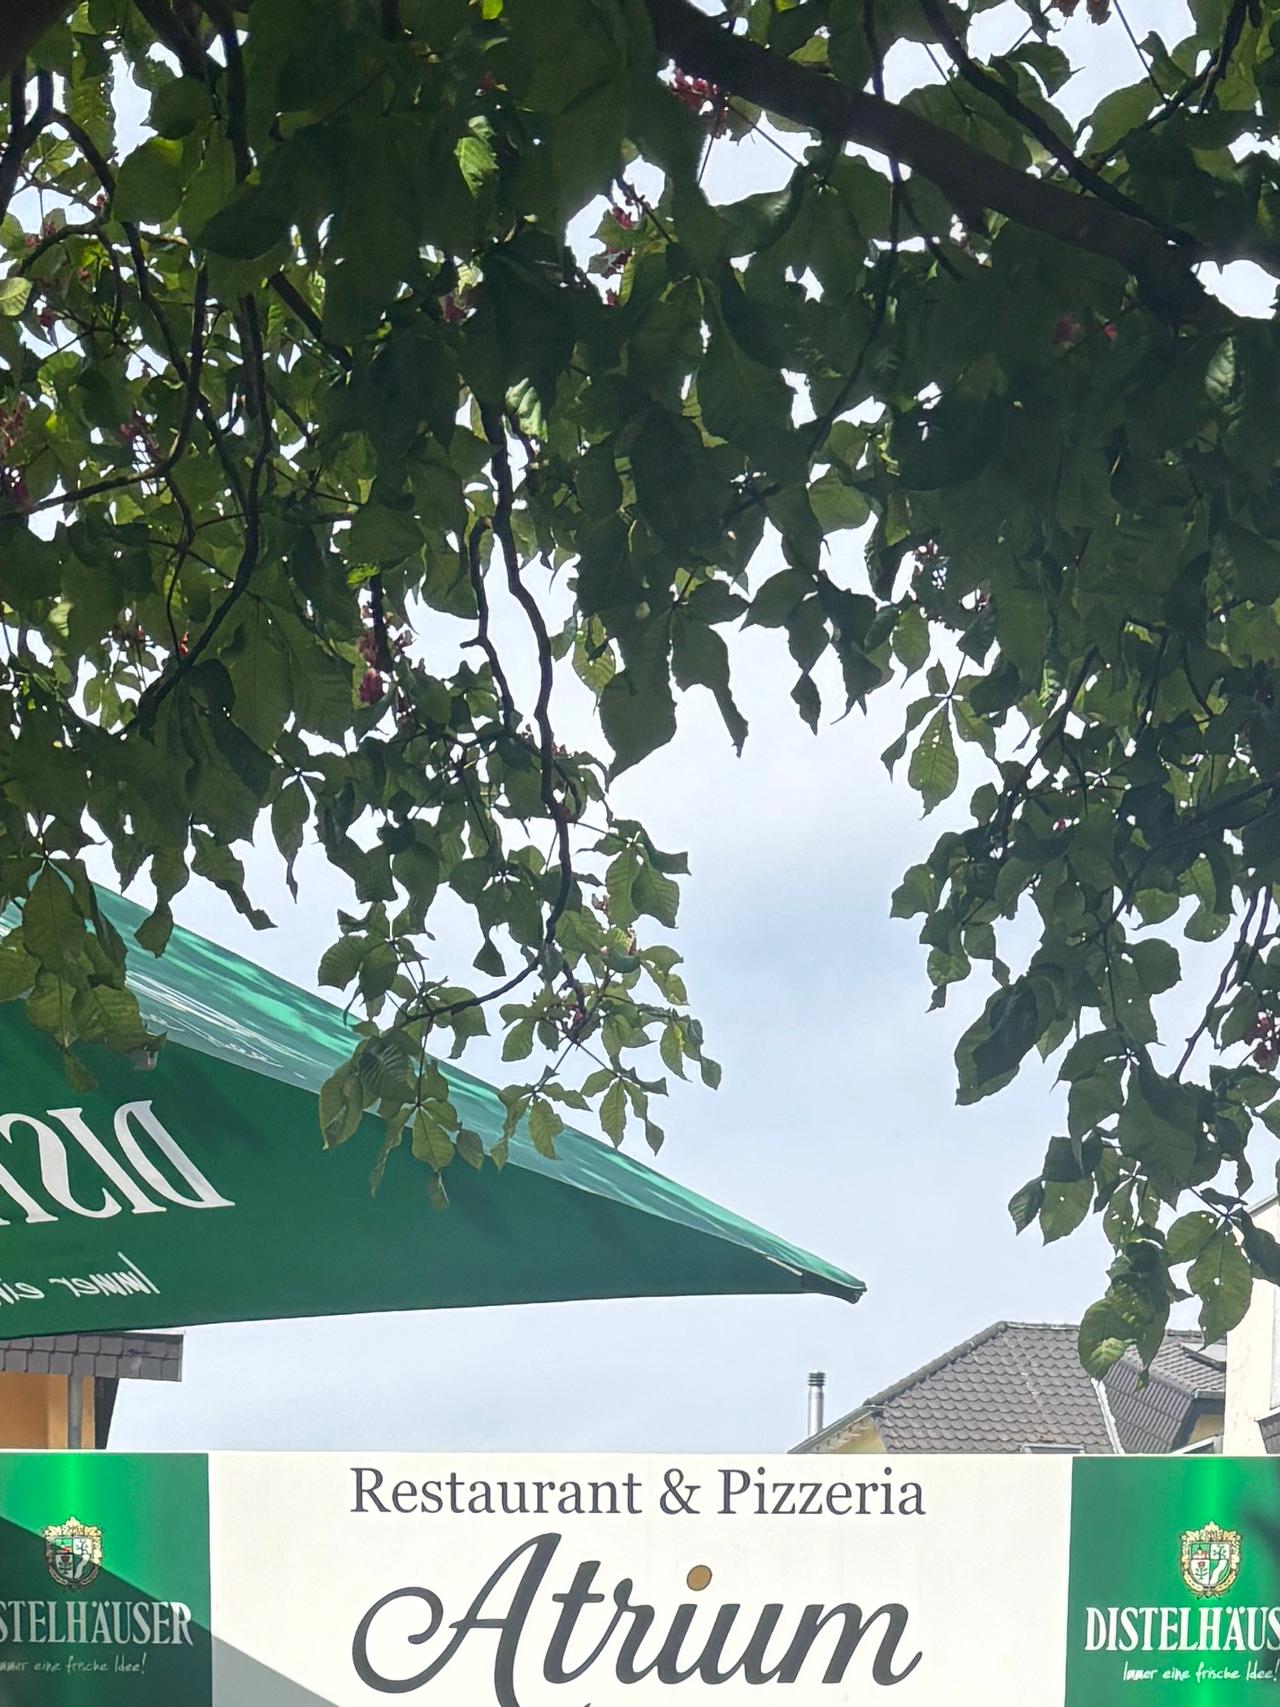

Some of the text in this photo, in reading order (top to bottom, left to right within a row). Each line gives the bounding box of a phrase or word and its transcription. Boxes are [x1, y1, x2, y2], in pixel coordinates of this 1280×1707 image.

[350, 1466, 926, 1516] Restaurant & Pizzeria
[114, 1651, 147, 1675] Idee!
[1123, 1657, 1280, 1683] Immer eine frische Idee!
